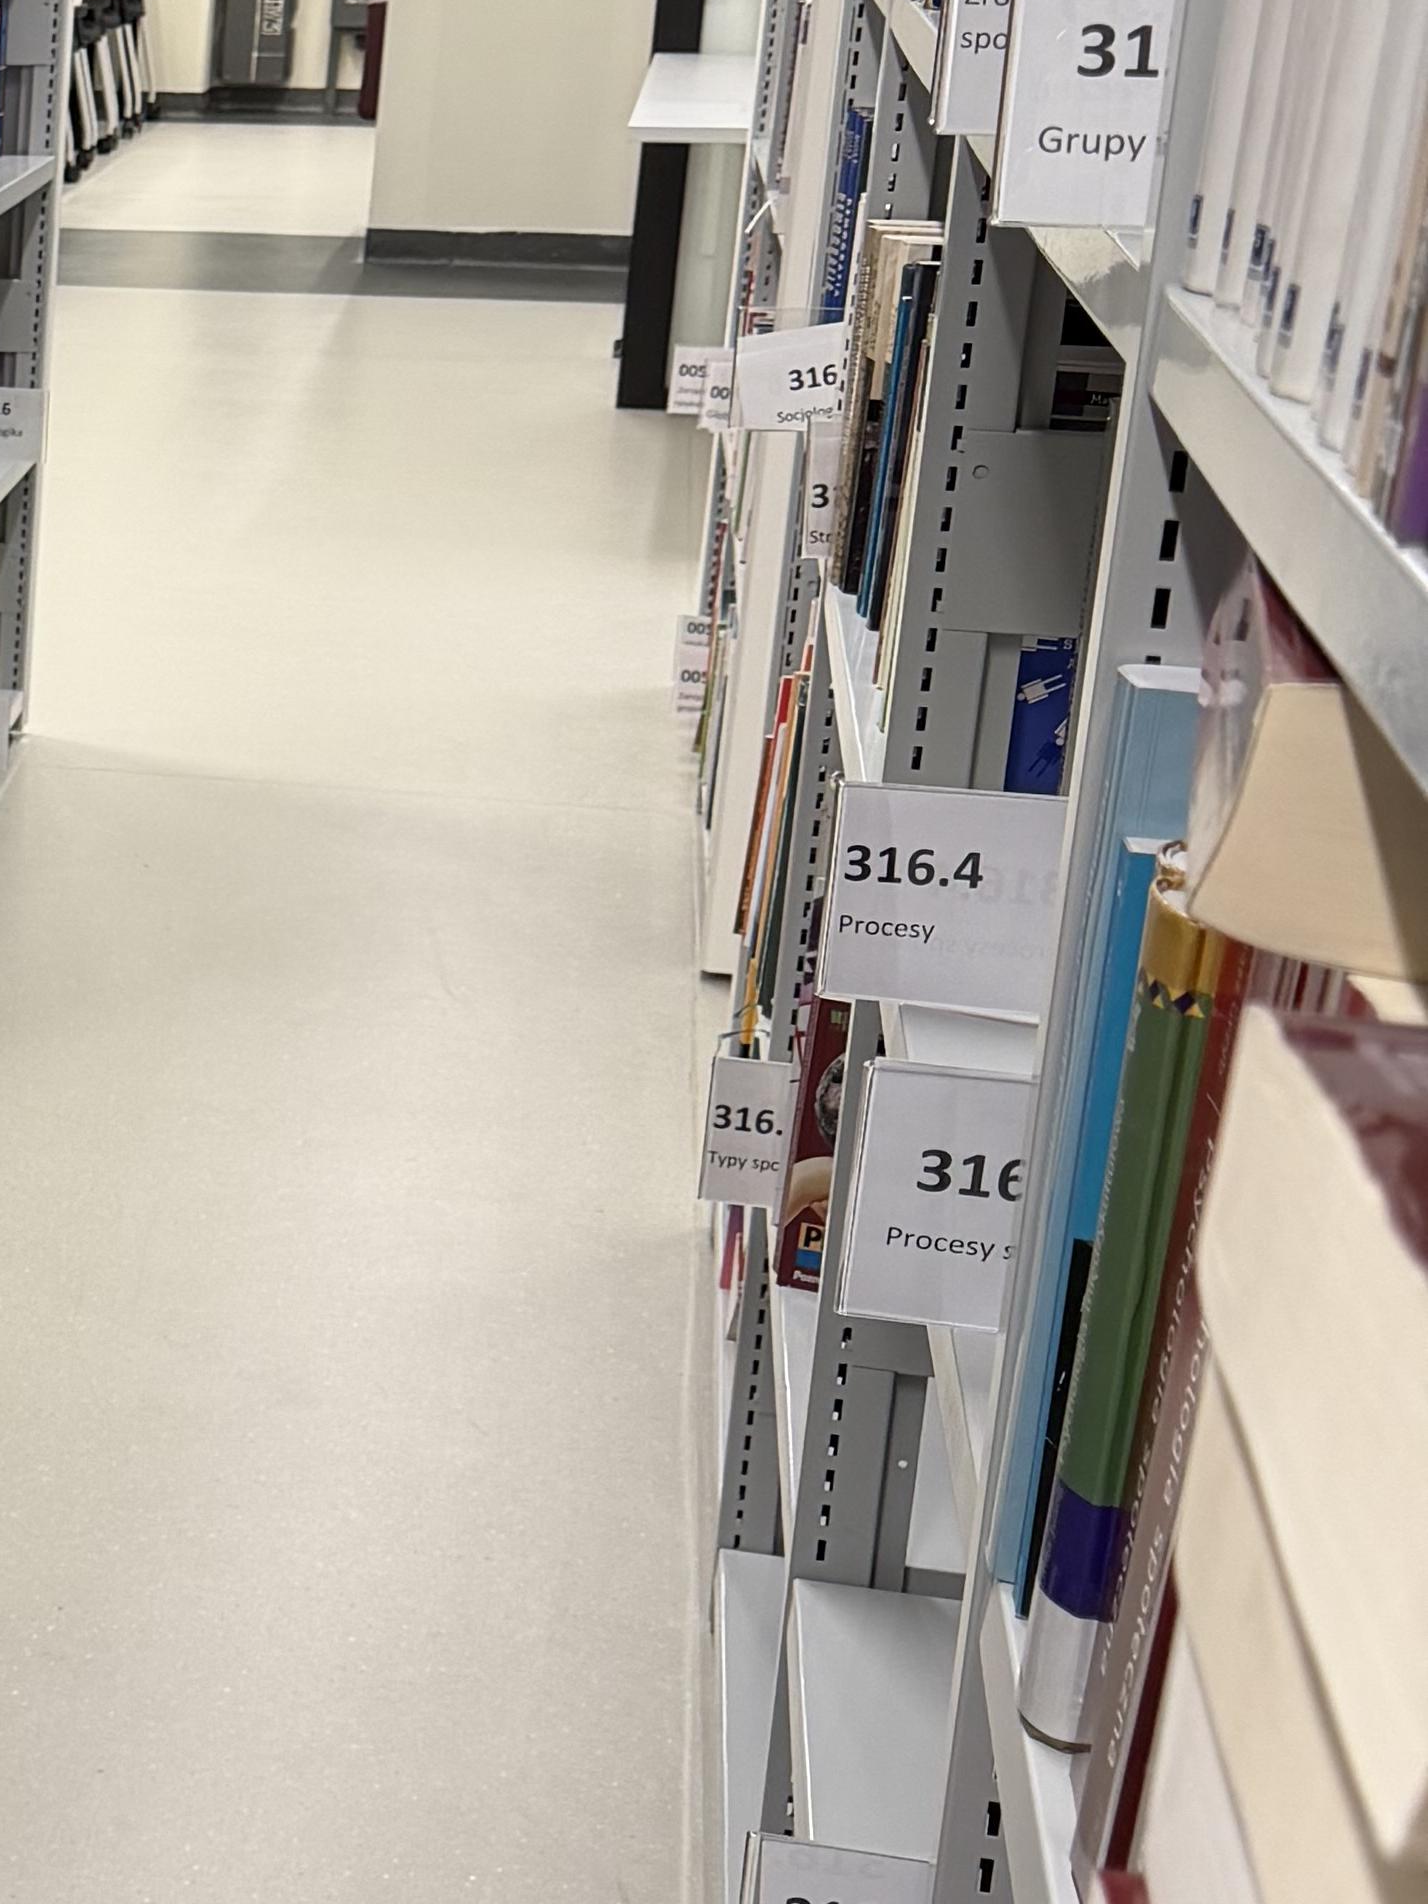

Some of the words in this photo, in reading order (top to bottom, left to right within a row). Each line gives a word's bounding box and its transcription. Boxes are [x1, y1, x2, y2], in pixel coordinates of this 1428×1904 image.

[960, 26, 1007, 54] spo
[1075, 22, 1161, 80] 31
[1038, 126, 1147, 163] Grupy
[788, 364, 838, 391] 316
[776, 406, 834, 424] Socjolog
[811, 483, 830, 509] 3
[809, 530, 832, 545] Str
[843, 842, 984, 891] 316.4
[837, 912, 936, 945] Procesy
[712, 1104, 783, 1136] 316.
[707, 1150, 748, 1171] Typy
[751, 1158, 781, 1173] spo
[915, 1148, 1023, 1204] 316
[884, 1225, 996, 1263] Procesy
